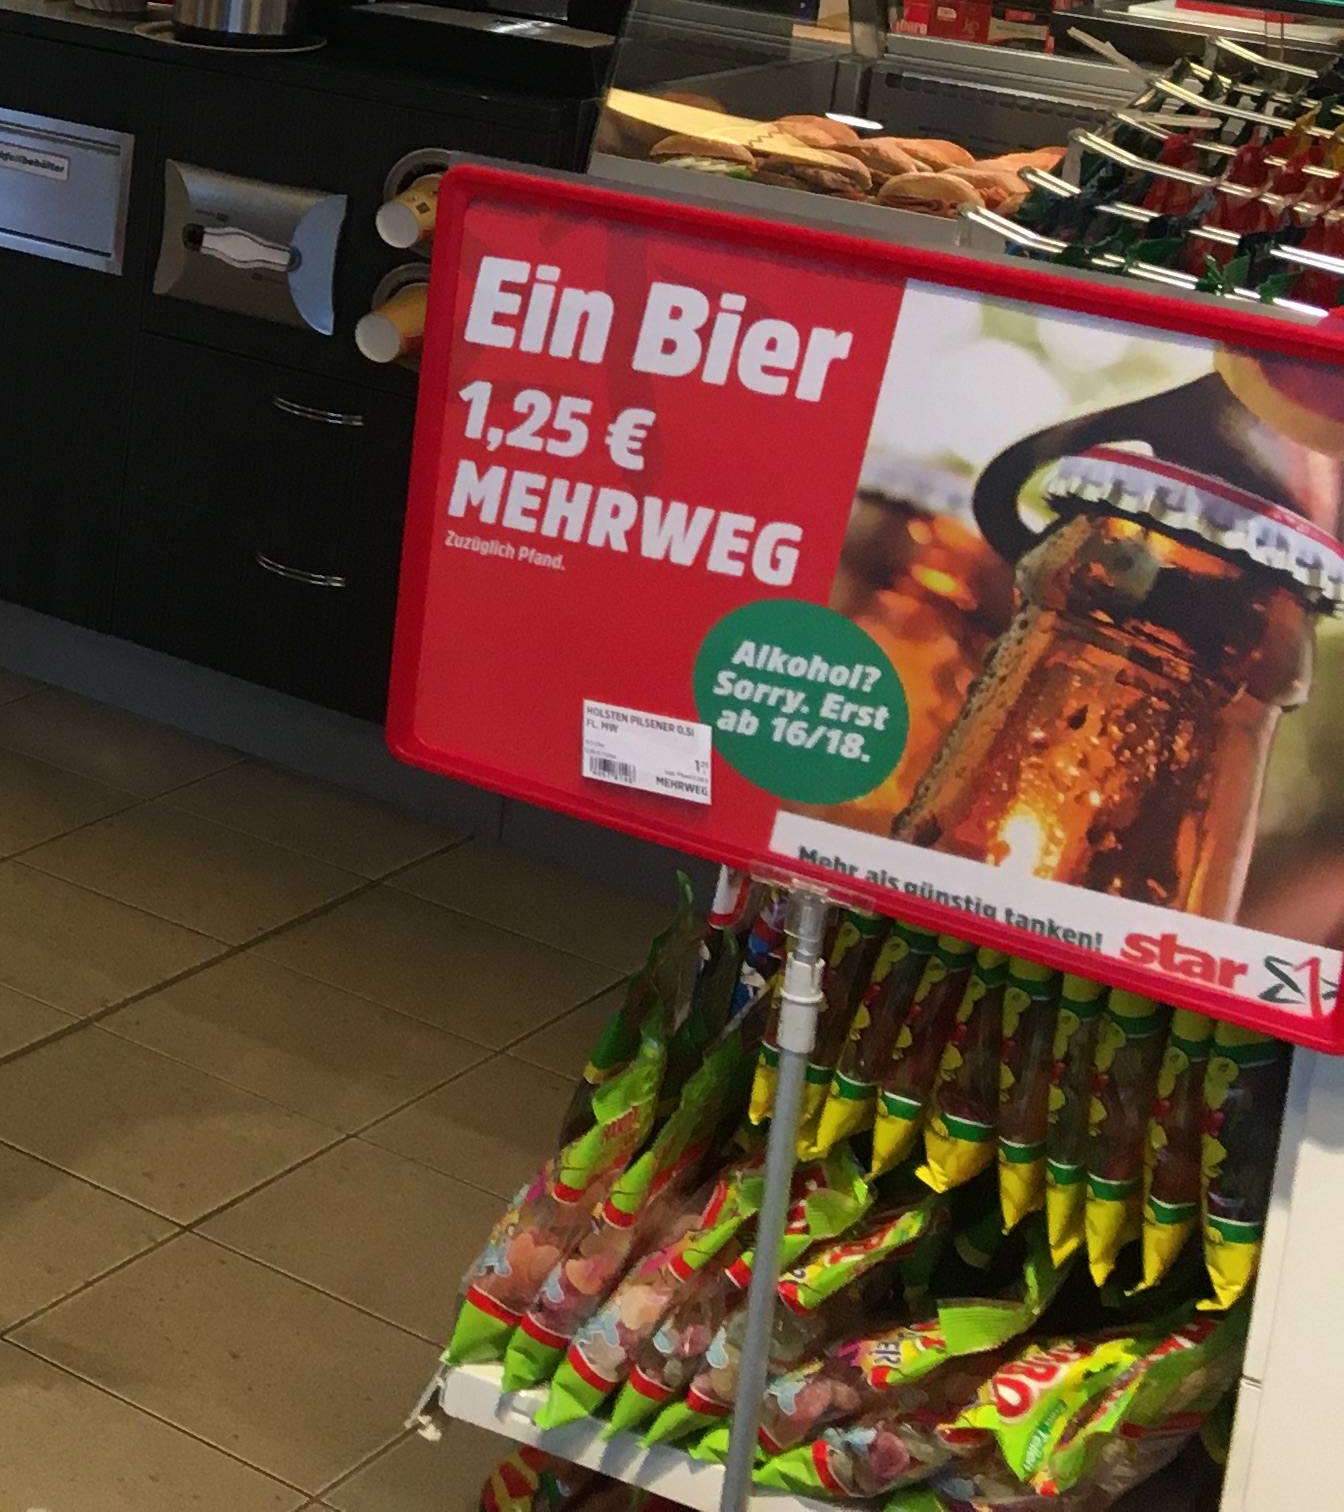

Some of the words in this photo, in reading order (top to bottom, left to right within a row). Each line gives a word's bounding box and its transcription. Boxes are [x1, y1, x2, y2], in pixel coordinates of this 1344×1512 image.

[464, 254, 612, 364] Ein
[631, 282, 852, 403] Bier
[458, 380, 593, 463] 1,25
[606, 407, 656, 470] €
[444, 531, 515, 561] Zuzüglich
[518, 544, 567, 572] Pfand.
[448, 459, 802, 588] MEHRWEG
[732, 640, 882, 694] Alkohol?
[586, 718, 599, 729] FL.
[601, 721, 619, 734] MW
[587, 706, 628, 723] HOLSTEN
[630, 716, 675, 733] PILSENER
[713, 670, 810, 717] Sorry.
[817, 692, 889, 730] Erst
[716, 706, 760, 740] ab
[767, 717, 871, 765] 16/18.
[656, 776, 709, 797] MEHRWEG
[798, 845, 860, 879] Mehr
[865, 862, 901, 890] als
[903, 878, 1000, 924] günstig
[1003, 903, 1104, 953] tanken!
[1118, 929, 1249, 989] star
